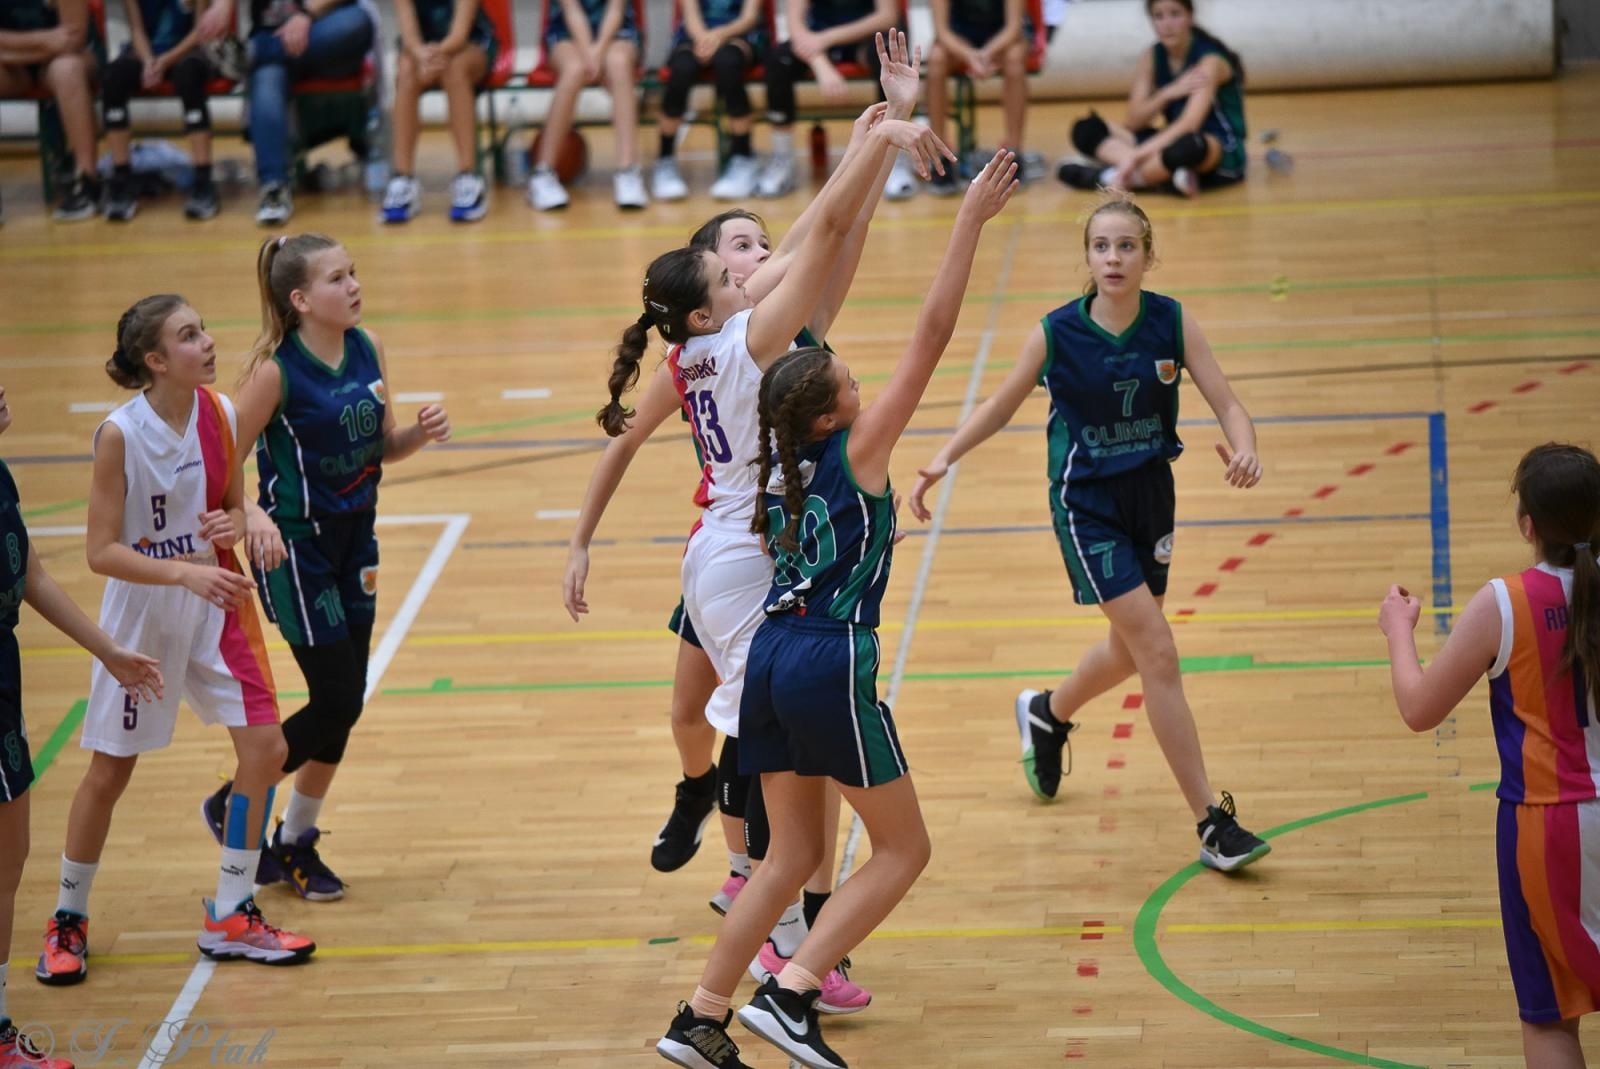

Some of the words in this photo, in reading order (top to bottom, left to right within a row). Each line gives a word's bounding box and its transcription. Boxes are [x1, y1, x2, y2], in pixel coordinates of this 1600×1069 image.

[1113, 378, 1140, 416] 7
[340, 399, 376, 442] 16
[684, 390, 732, 463] 13
[151, 494, 166, 532] 5
[5, 532, 21, 574] 8
[131, 533, 196, 559] MINI
[1088, 540, 1117, 578] 7
[123, 692, 139, 731] 5
[4, 729, 22, 772] 8
